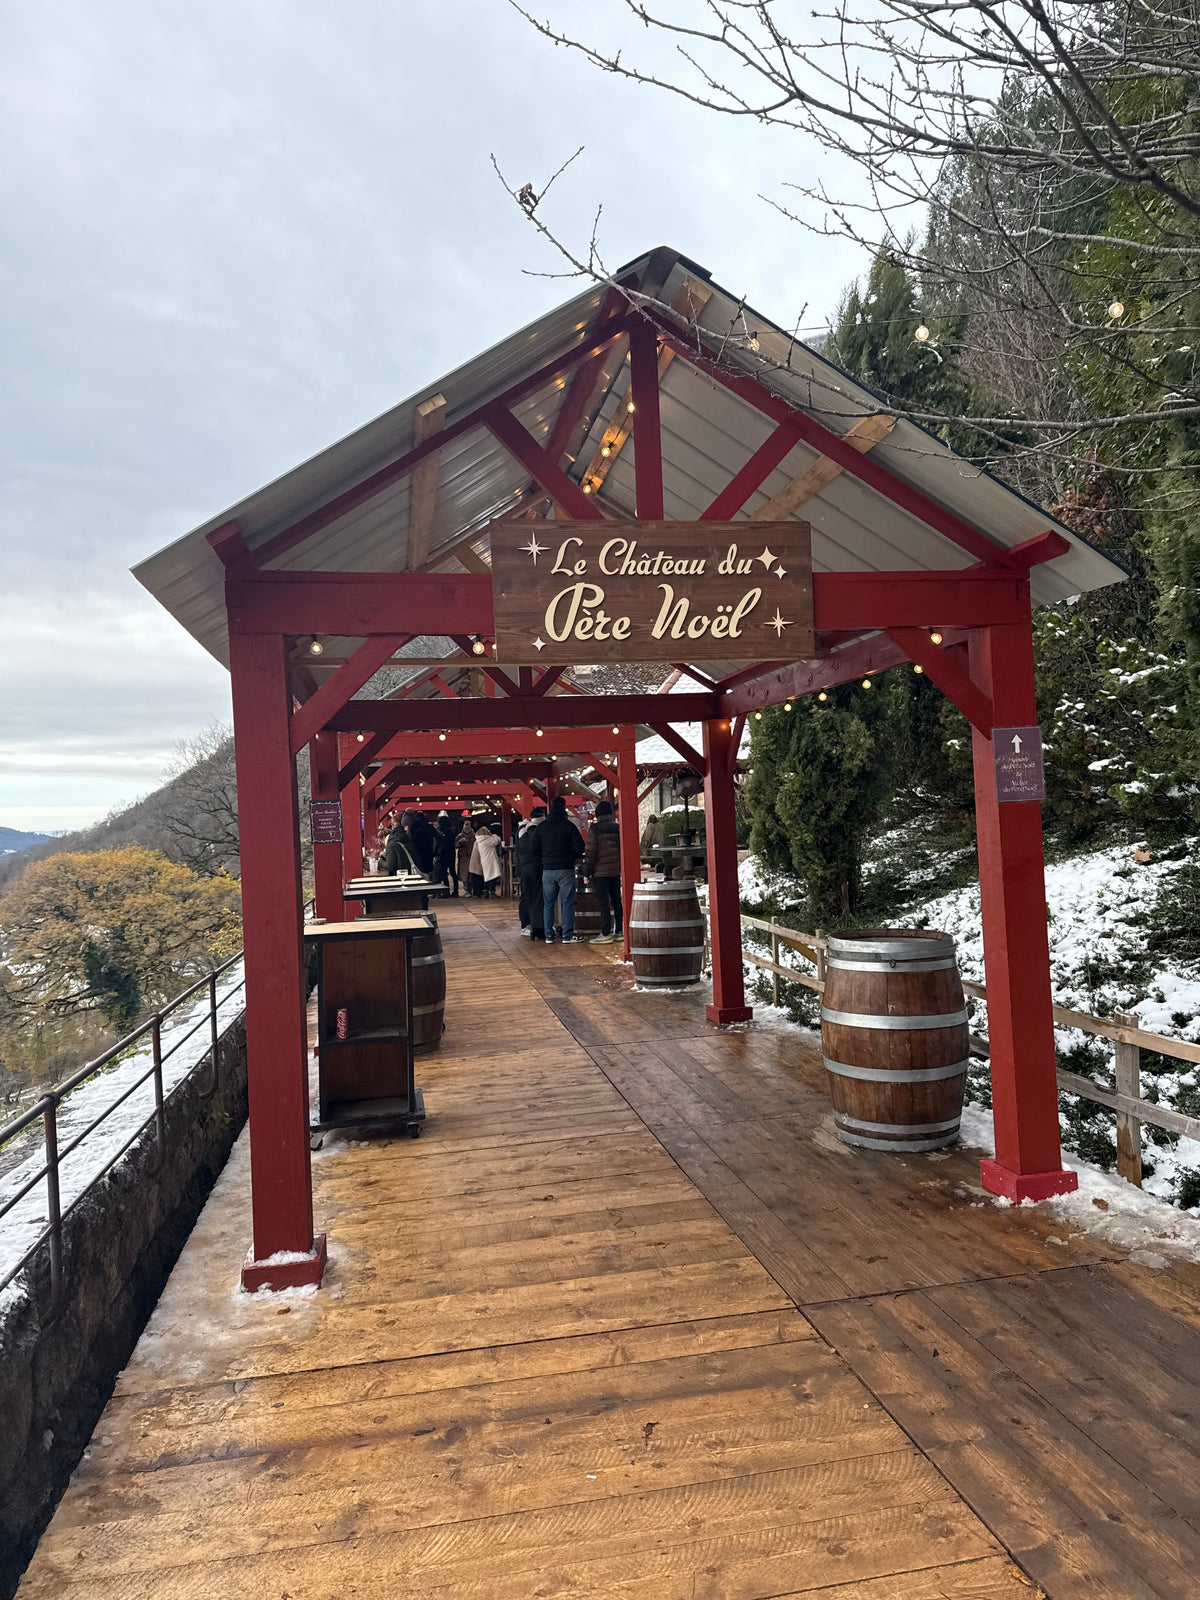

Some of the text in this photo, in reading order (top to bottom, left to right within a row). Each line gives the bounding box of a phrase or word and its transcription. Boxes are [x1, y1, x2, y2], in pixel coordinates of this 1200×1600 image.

[550, 537, 753, 577] Le Château du
[544, 582, 762, 642] Père Noël
